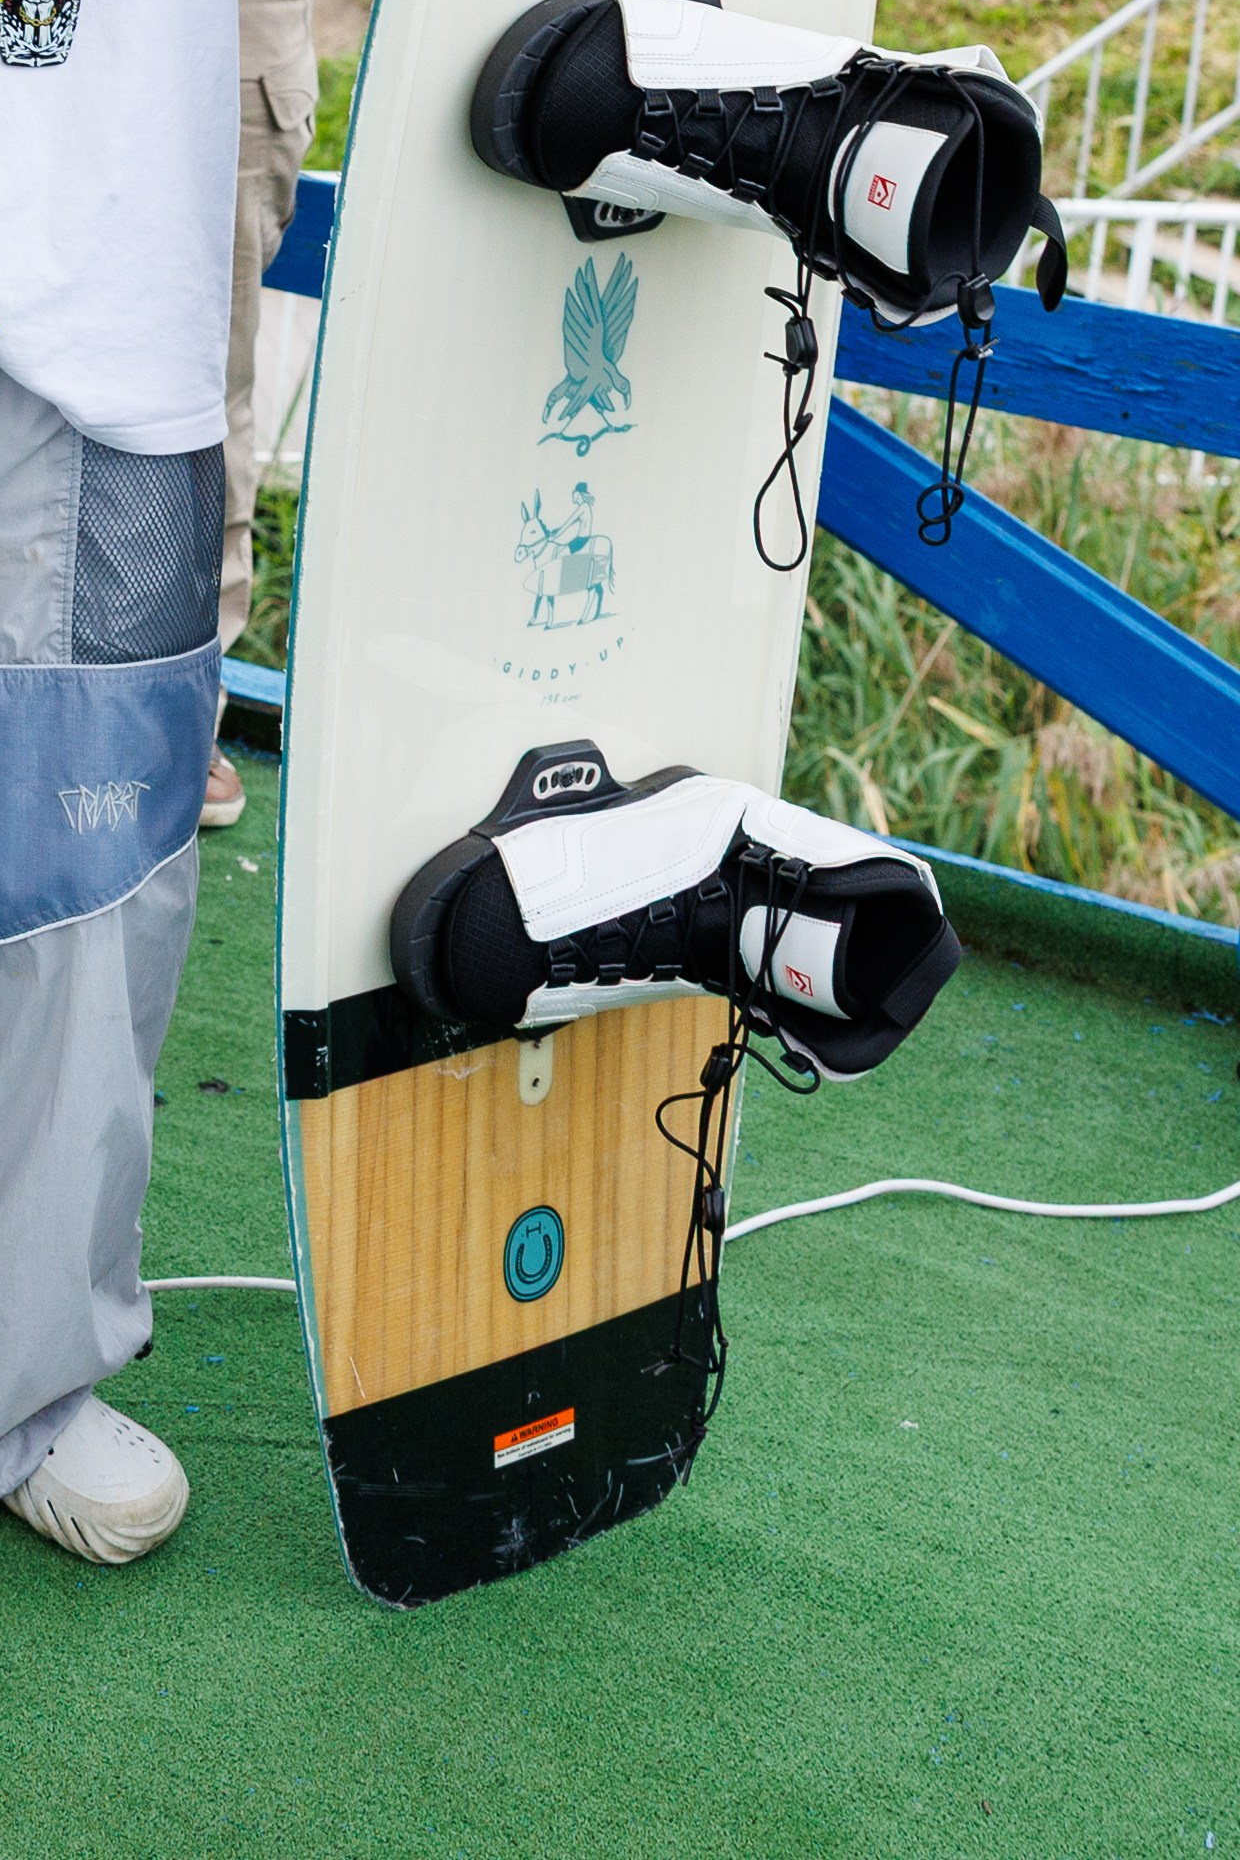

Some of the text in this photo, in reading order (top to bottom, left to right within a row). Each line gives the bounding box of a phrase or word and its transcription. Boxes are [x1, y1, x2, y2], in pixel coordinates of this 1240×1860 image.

[503, 636, 625, 682] GIDDY UP
[519, 1417, 559, 1439] WARNING
